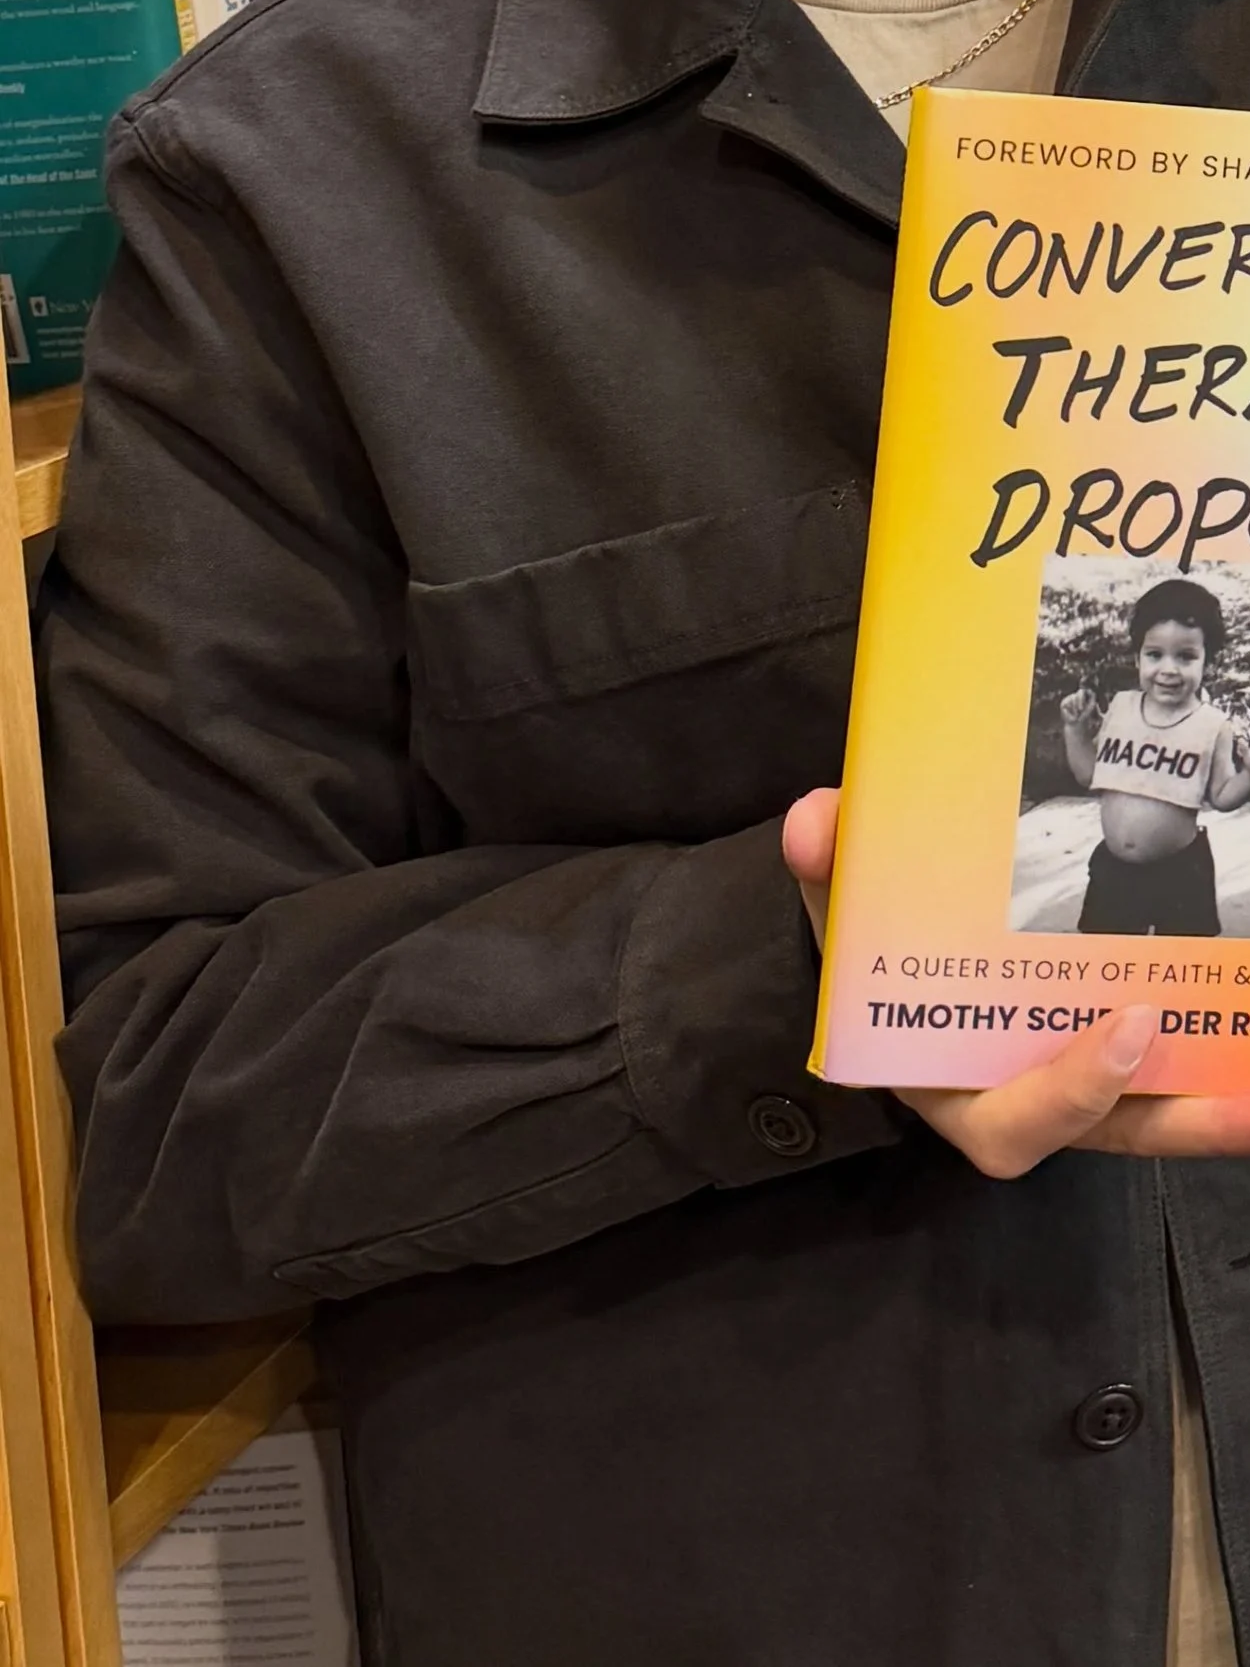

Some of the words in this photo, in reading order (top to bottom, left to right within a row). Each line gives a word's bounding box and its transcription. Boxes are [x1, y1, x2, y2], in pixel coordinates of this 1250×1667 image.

[956, 137, 1137, 172] FOREWORD
[1152, 152, 1188, 176] BY
[1097, 736, 1200, 780] MACHO
[872, 955, 888, 976] A
[901, 955, 989, 980] QUEER
[1002, 959, 1090, 982] STORY
[1100, 961, 1137, 982] OF
[1147, 963, 1223, 985] FAITH
[867, 1002, 1019, 1032] TIMOTHY
[1026, 1005, 1221, 1037] SCHDER
